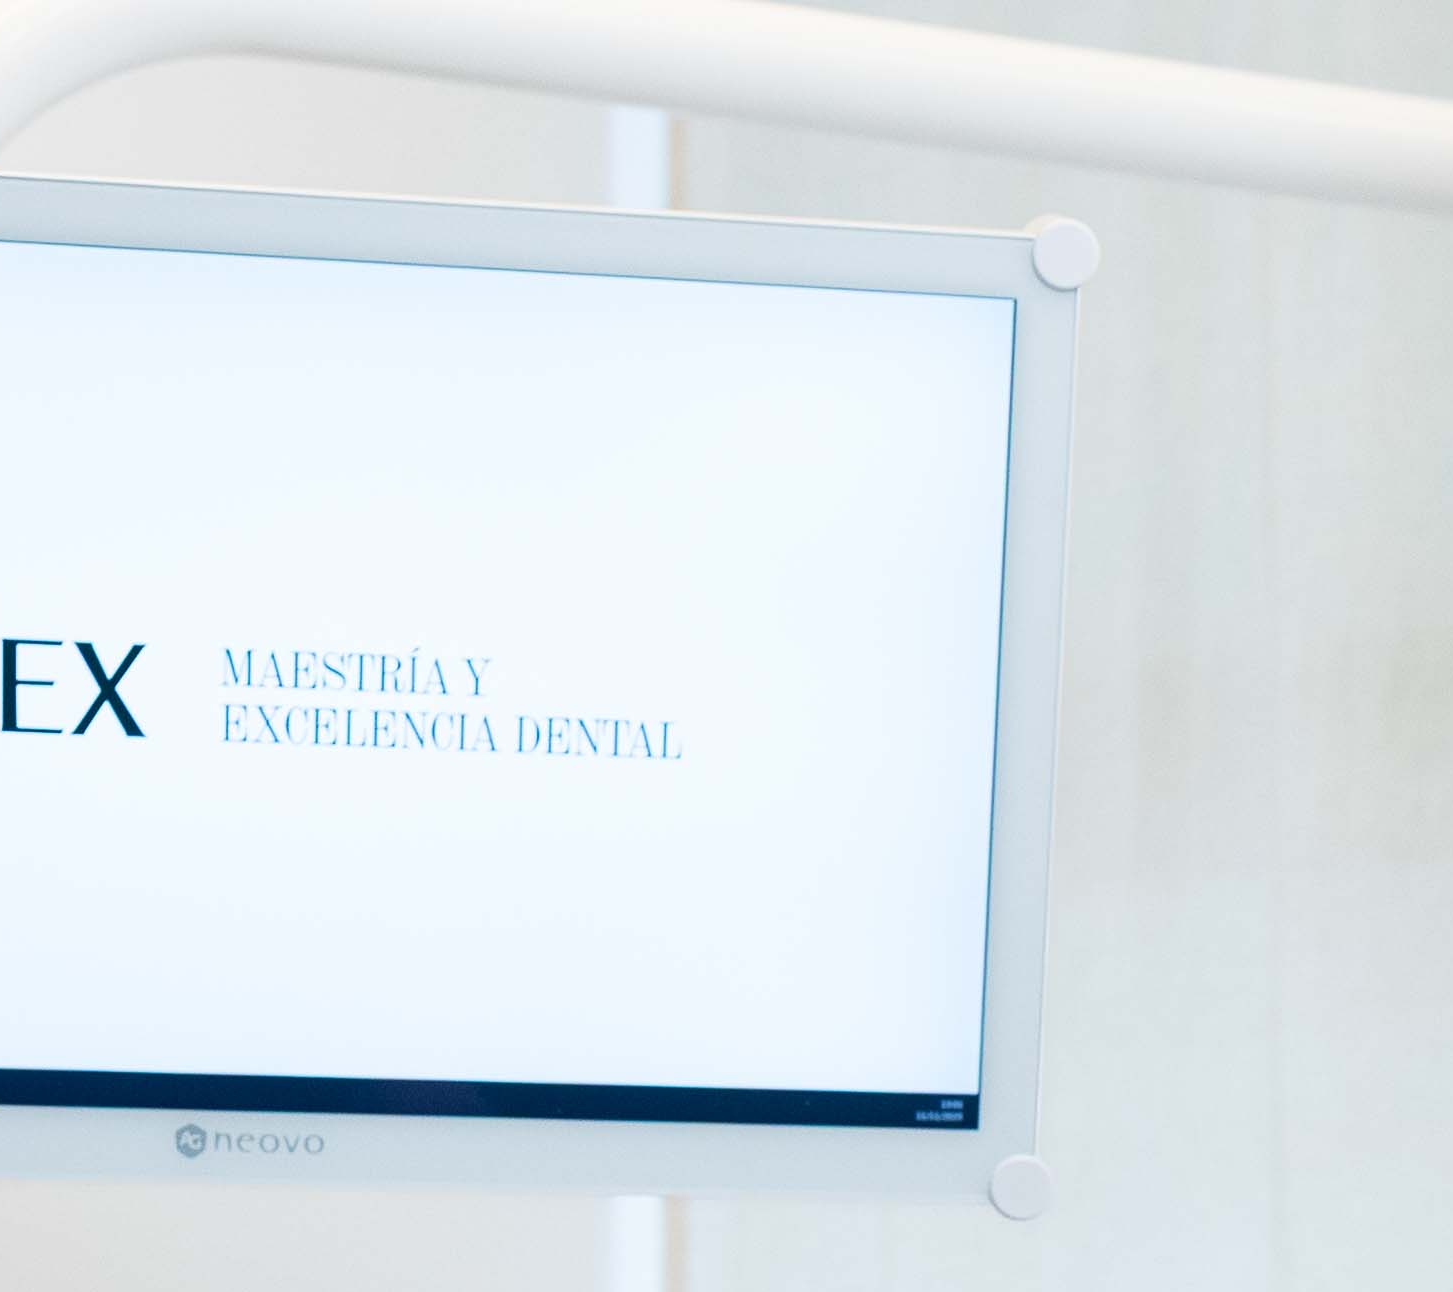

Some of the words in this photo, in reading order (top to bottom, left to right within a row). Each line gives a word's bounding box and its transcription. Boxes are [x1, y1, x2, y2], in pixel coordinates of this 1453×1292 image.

[220, 645, 453, 698] MAESTRÍA
[462, 656, 493, 699] Y
[221, 703, 499, 753] EXCELENCIA
[514, 714, 684, 761] DENTAL
[213, 1131, 326, 1154] neovo
